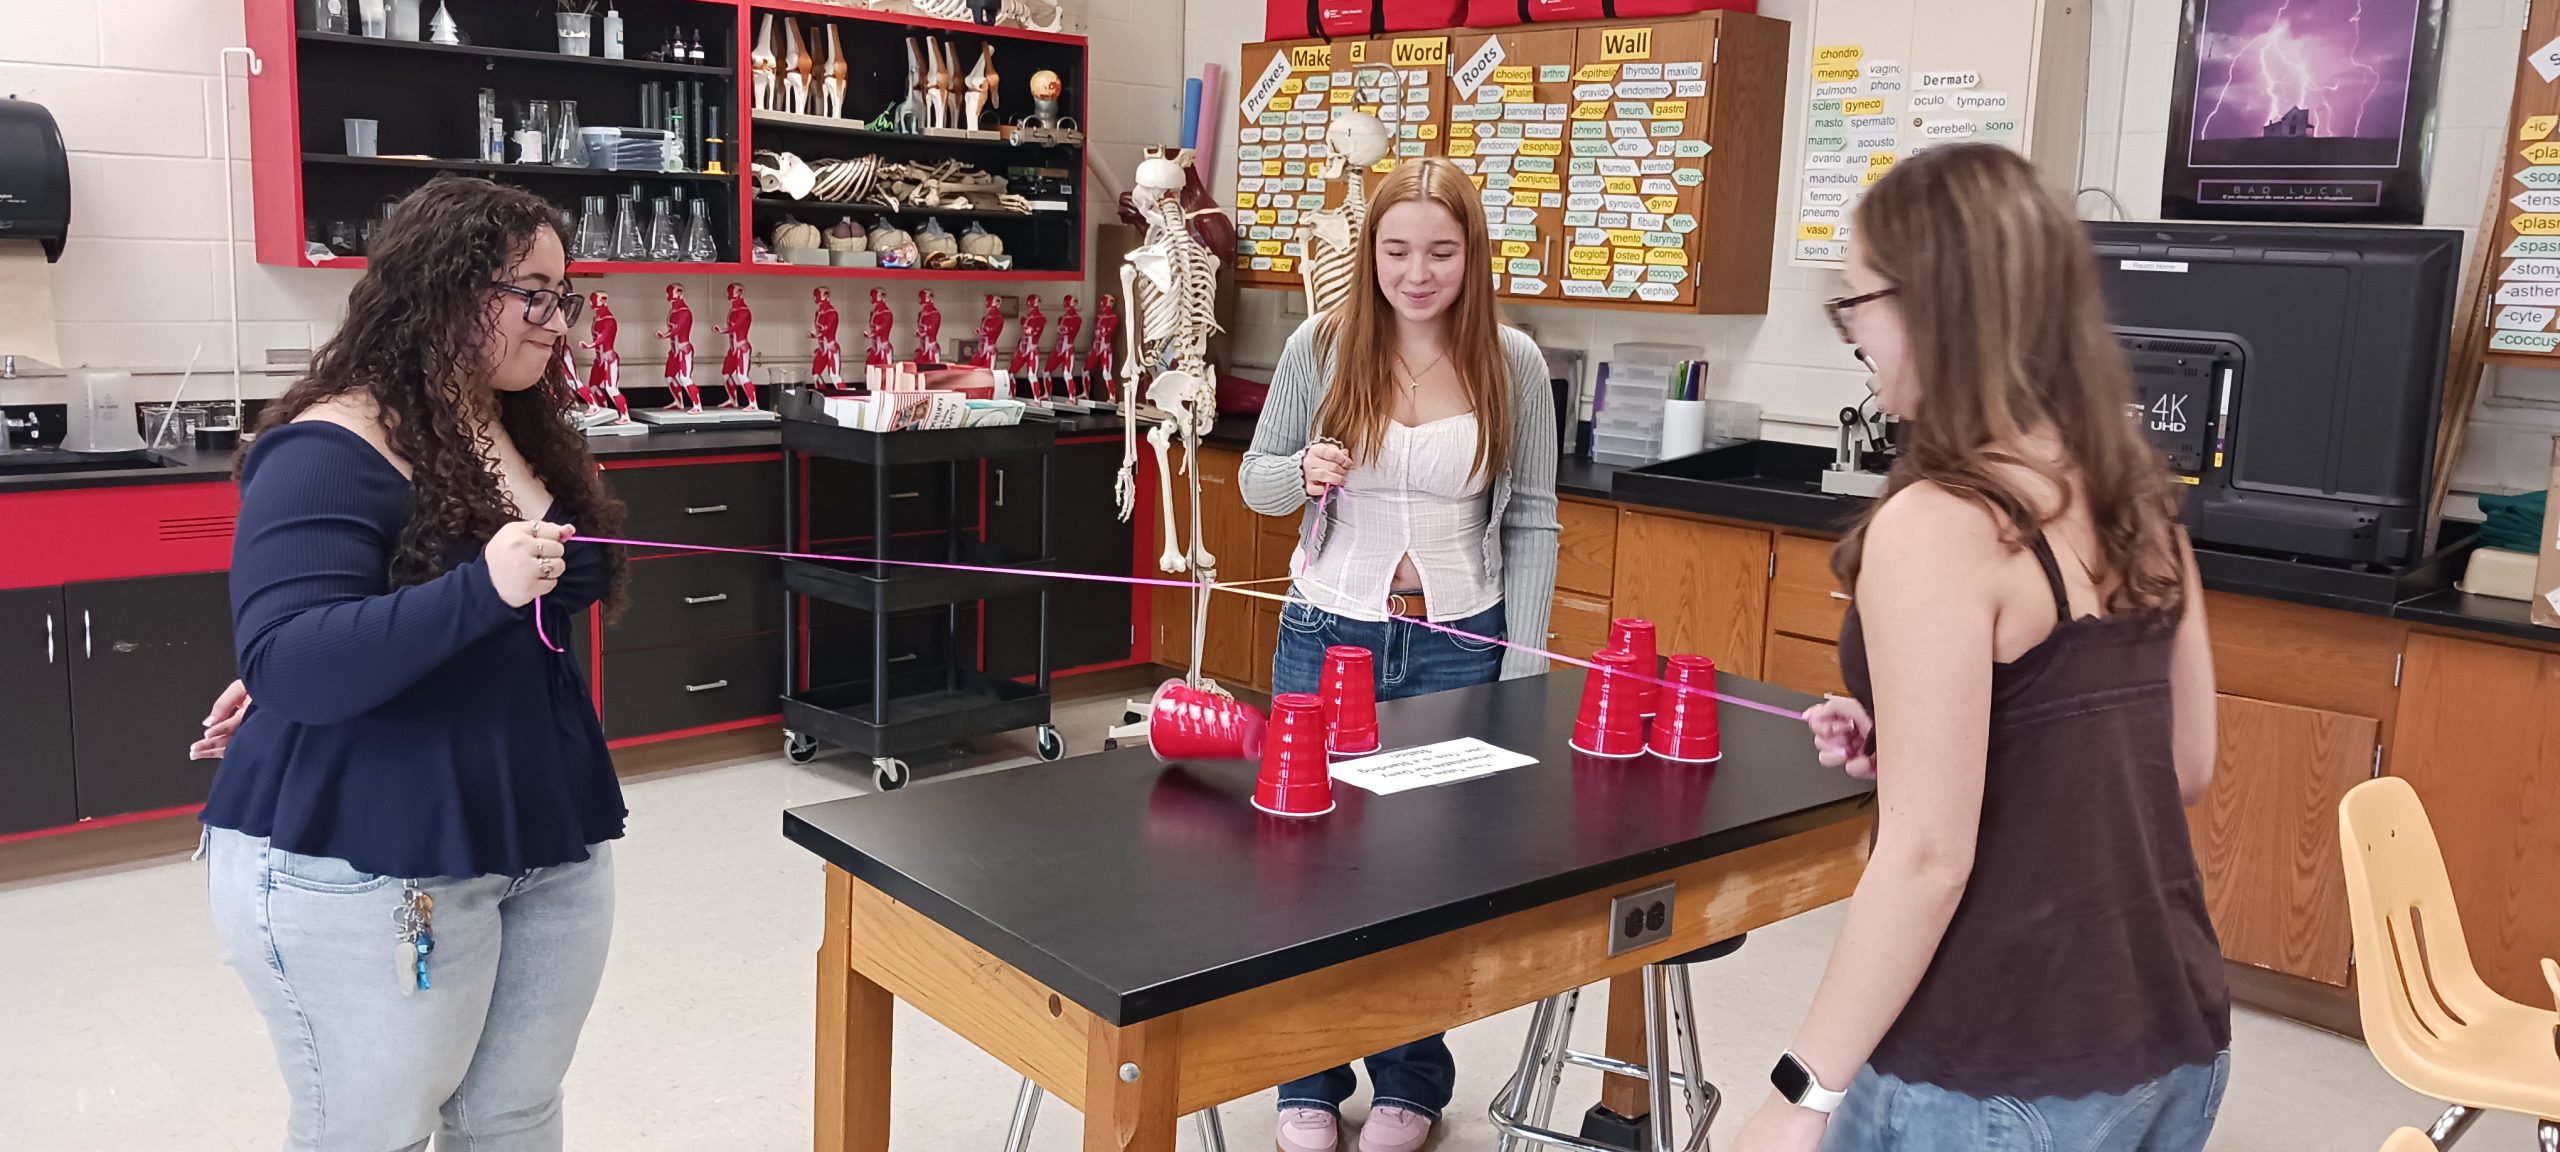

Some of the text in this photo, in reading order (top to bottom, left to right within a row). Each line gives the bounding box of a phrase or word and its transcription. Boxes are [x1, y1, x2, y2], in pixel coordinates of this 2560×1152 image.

[1294, 32, 1647, 67] Make a Word Wall
[1820, 48, 1859, 59] chondro
[1461, 47, 1497, 87] Roots
[1625, 66, 1660, 76] thyroido
[1667, 67, 1698, 76] maxillo
[1542, 69, 1566, 79] arthro
[1817, 69, 1859, 80] meningo
[1923, 74, 1975, 86] Dermato
[1247, 62, 1285, 112] Prefixes
[1678, 84, 1703, 94] pyelo
[1816, 86, 1857, 96] pulmono
[1870, 81, 1901, 91] phono
[1579, 87, 1609, 98] gravido
[1914, 95, 1944, 106] oculo
[1956, 96, 2006, 108] tympano
[1547, 106, 1566, 116] opto
[1619, 106, 1644, 115] neuro
[1655, 105, 1685, 117] gastro
[1812, 101, 1840, 111] sclero
[1845, 100, 1881, 112] gyneco
[1815, 118, 1844, 127] masto
[1850, 117, 1896, 128] spermato
[1985, 121, 2014, 131] sono
[2529, 122, 2548, 132] -ic
[1573, 125, 1602, 136] phreno
[1926, 122, 1977, 135] cerebello
[1618, 142, 1638, 151] duro
[1857, 137, 1895, 148] acousto
[1575, 144, 1608, 154] scapulo
[1682, 144, 1699, 153] oxo
[1846, 155, 1868, 164] auro
[1870, 156, 1894, 167] pubo
[1809, 173, 1858, 184] mandibulo
[1609, 181, 1631, 190] radio
[2233, 185, 2344, 195] BAD LUCK
[1570, 195, 1599, 205] adreno
[1809, 191, 1842, 201] femoro
[1651, 199, 1673, 209] gyno
[1802, 208, 1840, 218] pneumo
[1672, 217, 1693, 227] teno
[1806, 226, 1828, 235] vaso
[1613, 233, 1641, 243] mento
[1615, 251, 1641, 261] osteo
[1804, 246, 1829, 256] spino
[1641, 285, 1676, 298] cephalo
[2504, 311, 2543, 324] -cyte
[2499, 334, 2559, 347] -coccus
[2151, 393, 2188, 423] 4K
[2150, 421, 2186, 432] UHD
